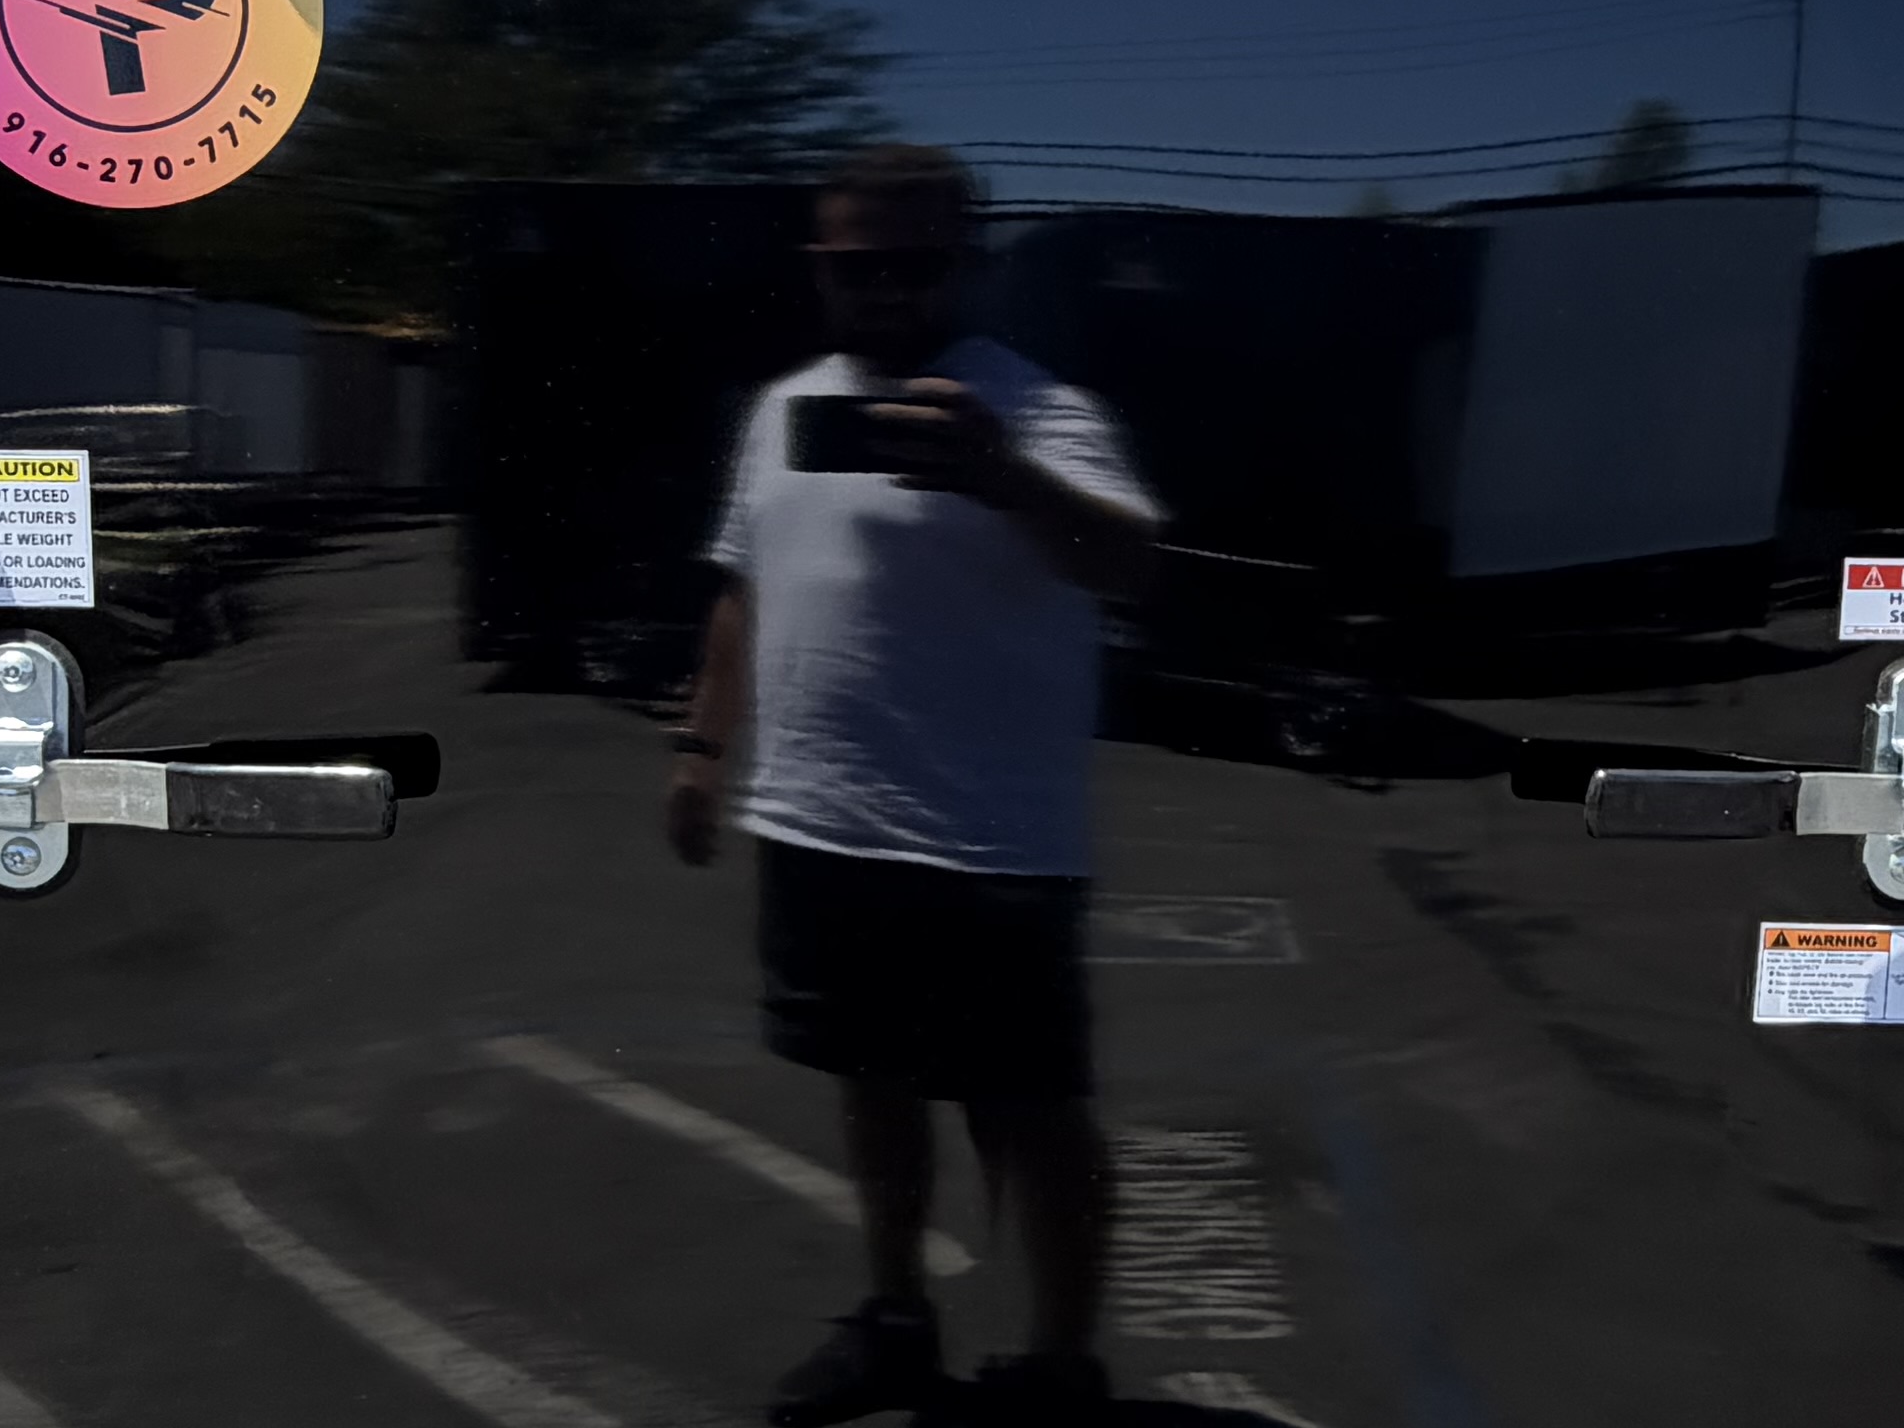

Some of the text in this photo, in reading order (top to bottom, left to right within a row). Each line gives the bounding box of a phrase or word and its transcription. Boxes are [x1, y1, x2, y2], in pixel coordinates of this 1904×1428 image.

[2, 83, 278, 185] 916-270-7715
[14, 489, 70, 503] EXCEED
[17, 533, 73, 547] WEIGHT
[3, 555, 23, 568] OR
[27, 556, 86, 569] LOADING
[1796, 933, 1878, 948] WARNING
